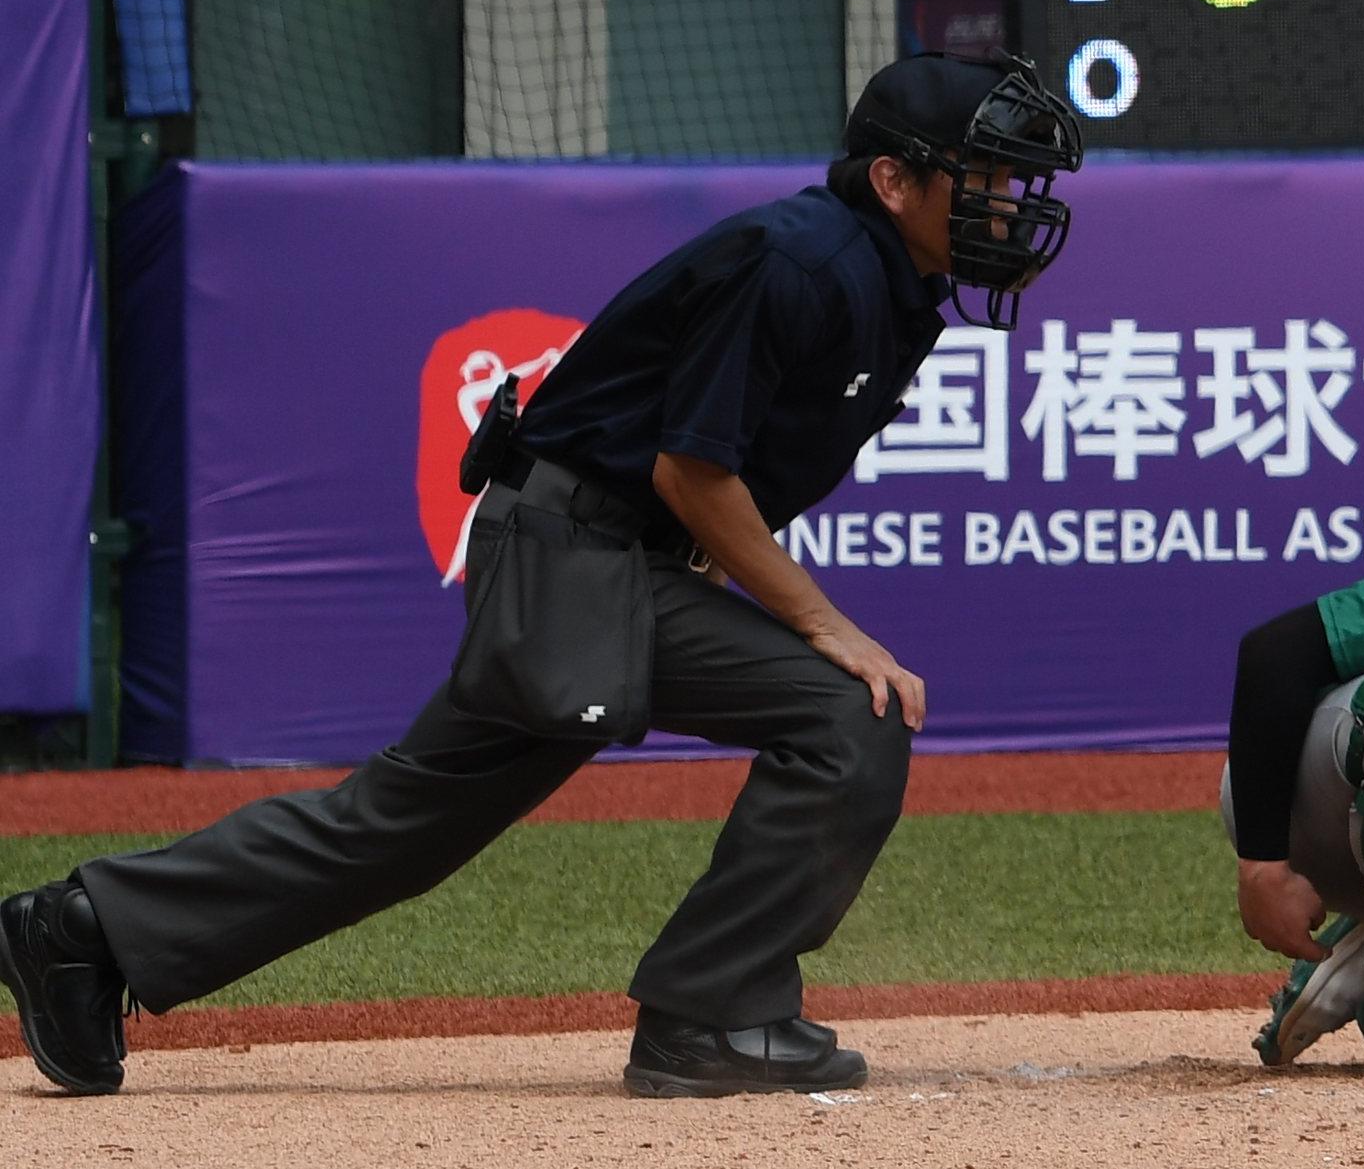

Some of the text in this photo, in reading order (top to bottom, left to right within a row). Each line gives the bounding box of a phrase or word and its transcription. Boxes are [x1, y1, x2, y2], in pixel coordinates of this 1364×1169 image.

[1067, 39, 1140, 118] O
[780, 511, 943, 567] NESE
[964, 508, 1267, 566] BASEBALL
